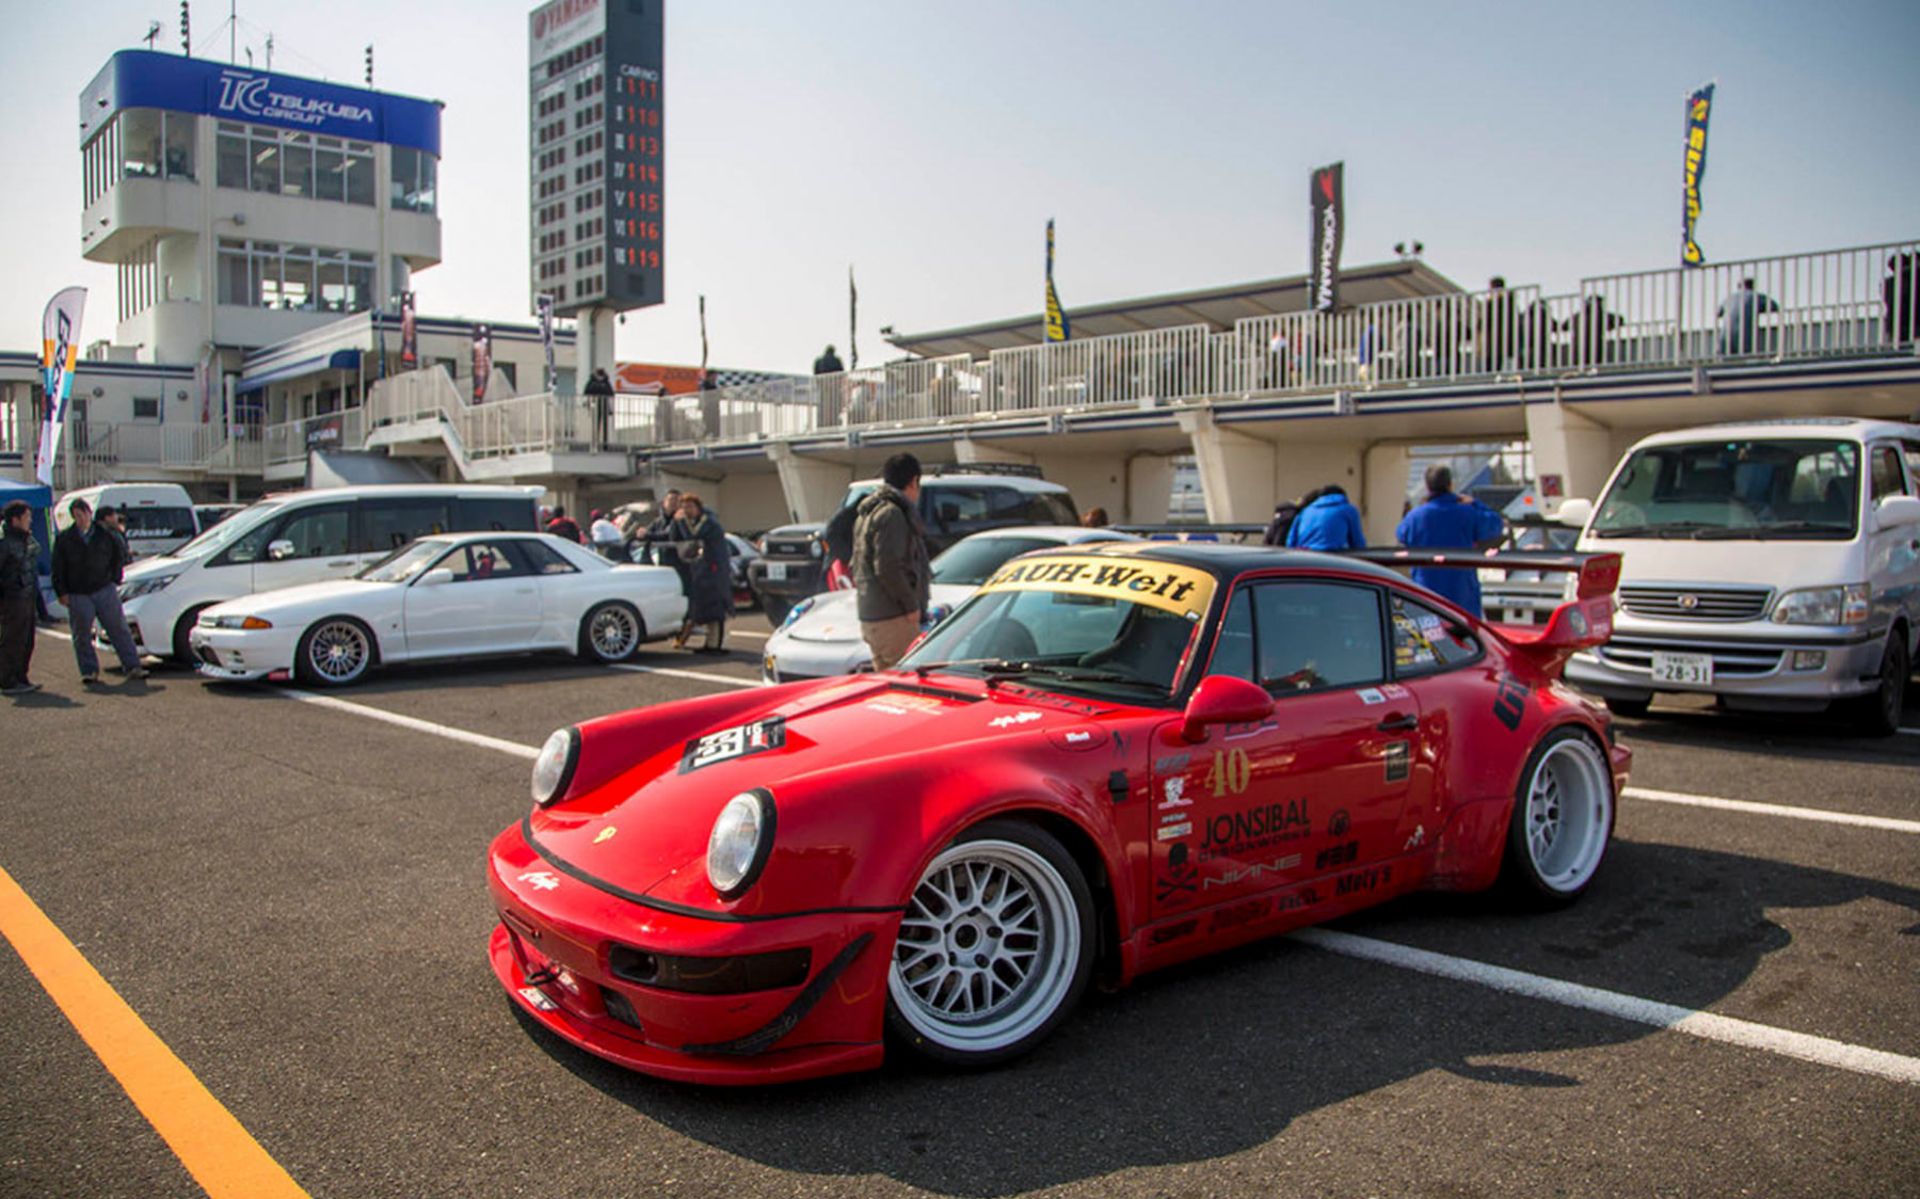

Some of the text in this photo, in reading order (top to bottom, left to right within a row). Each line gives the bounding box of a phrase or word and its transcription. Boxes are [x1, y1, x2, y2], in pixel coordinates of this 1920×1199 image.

[262, 106, 326, 126] CIRCUIT
[268, 92, 374, 123] TSUKUBA
[627, 190, 658, 212] 115
[627, 219, 658, 240] 116
[627, 247, 658, 269] 119
[1316, 203, 1336, 310] YOKOHAMA
[1204, 747, 1251, 798] 40
[1201, 797, 1311, 849] JONSIBAL
